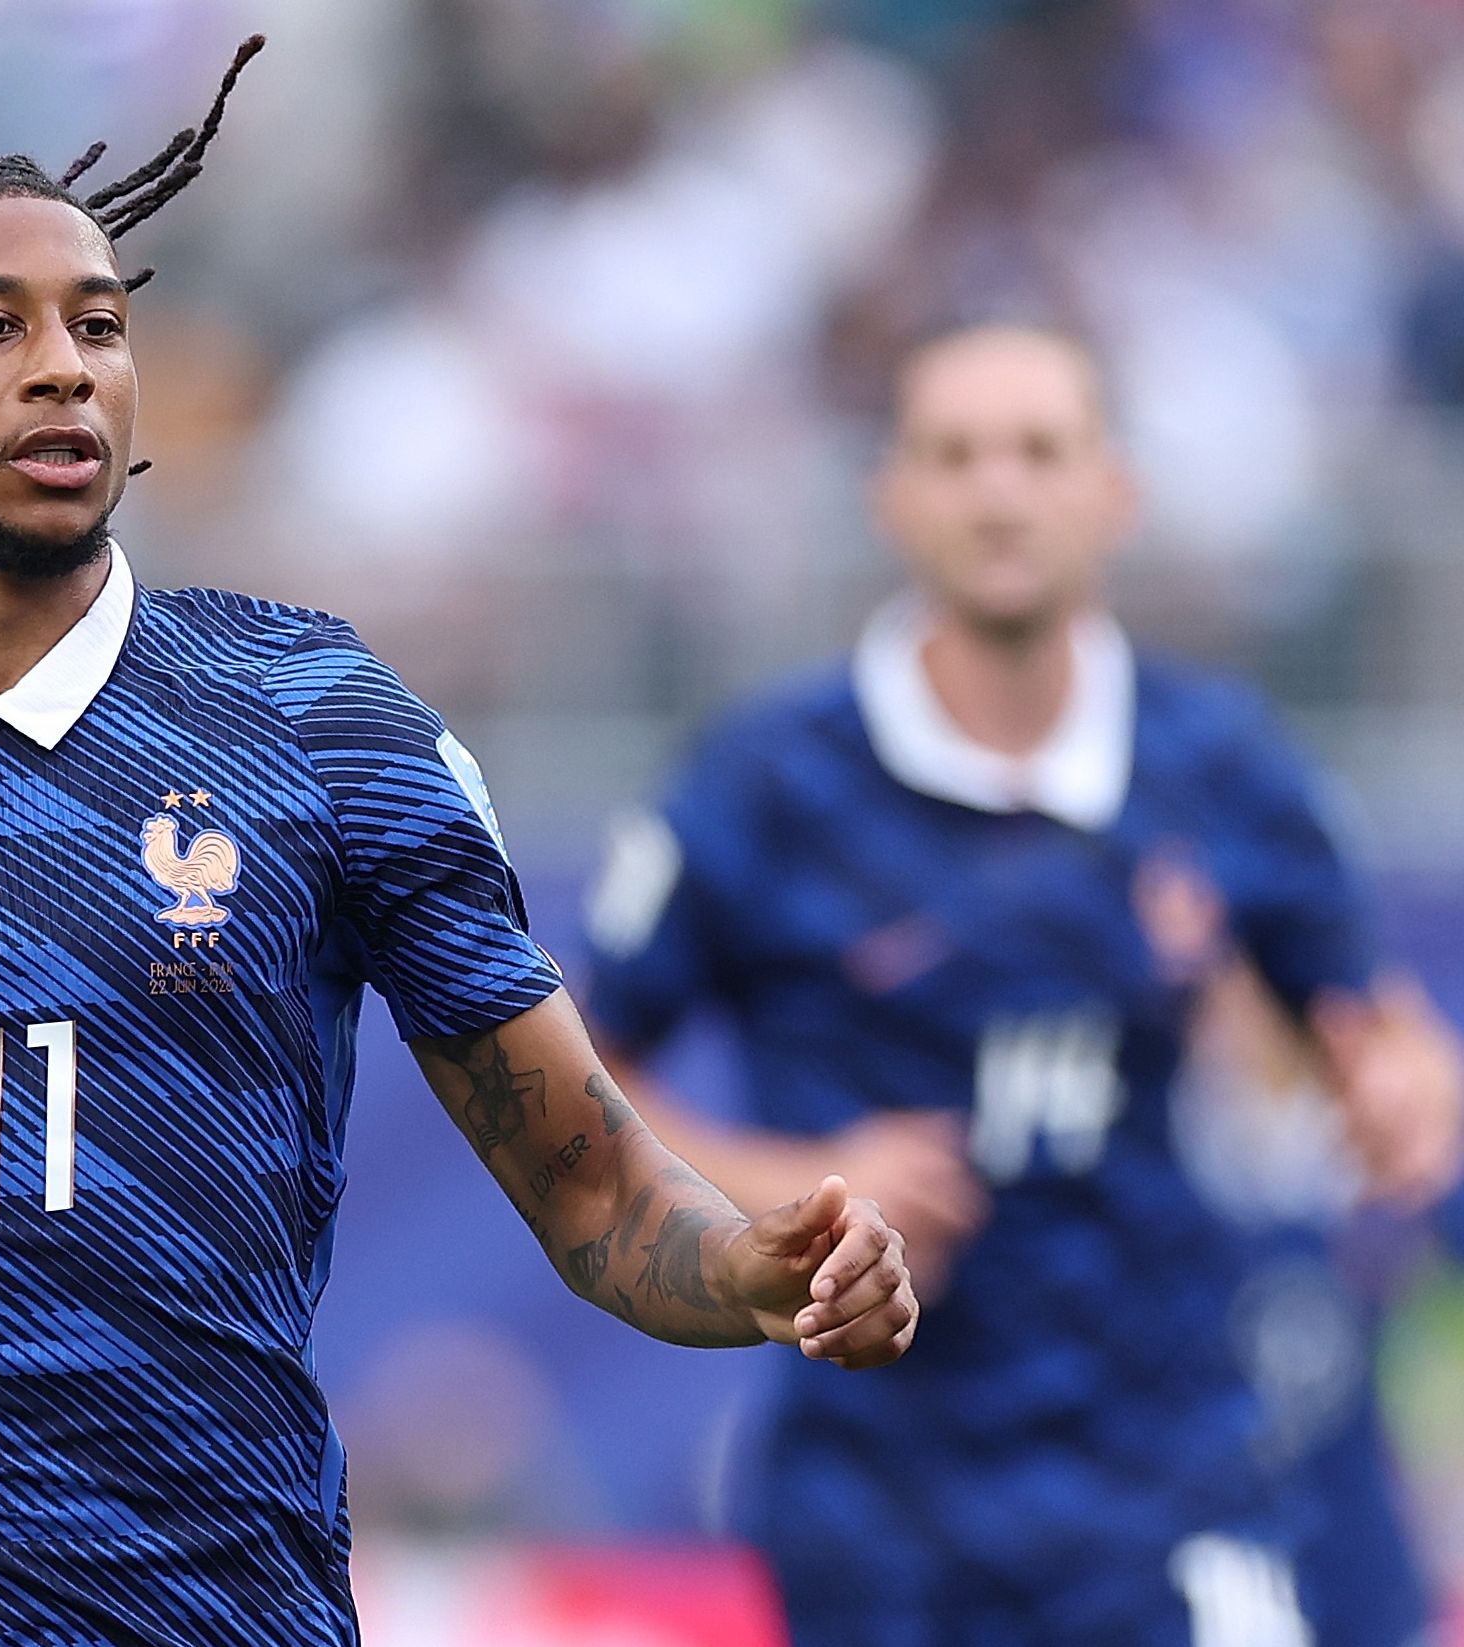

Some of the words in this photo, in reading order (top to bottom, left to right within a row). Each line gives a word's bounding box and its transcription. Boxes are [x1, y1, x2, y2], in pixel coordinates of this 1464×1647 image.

[173, 932, 220, 949] FFF
[150, 961, 196, 978] FRANCE
[148, 978, 167, 995] 22
[172, 978, 196, 994] JUIN
